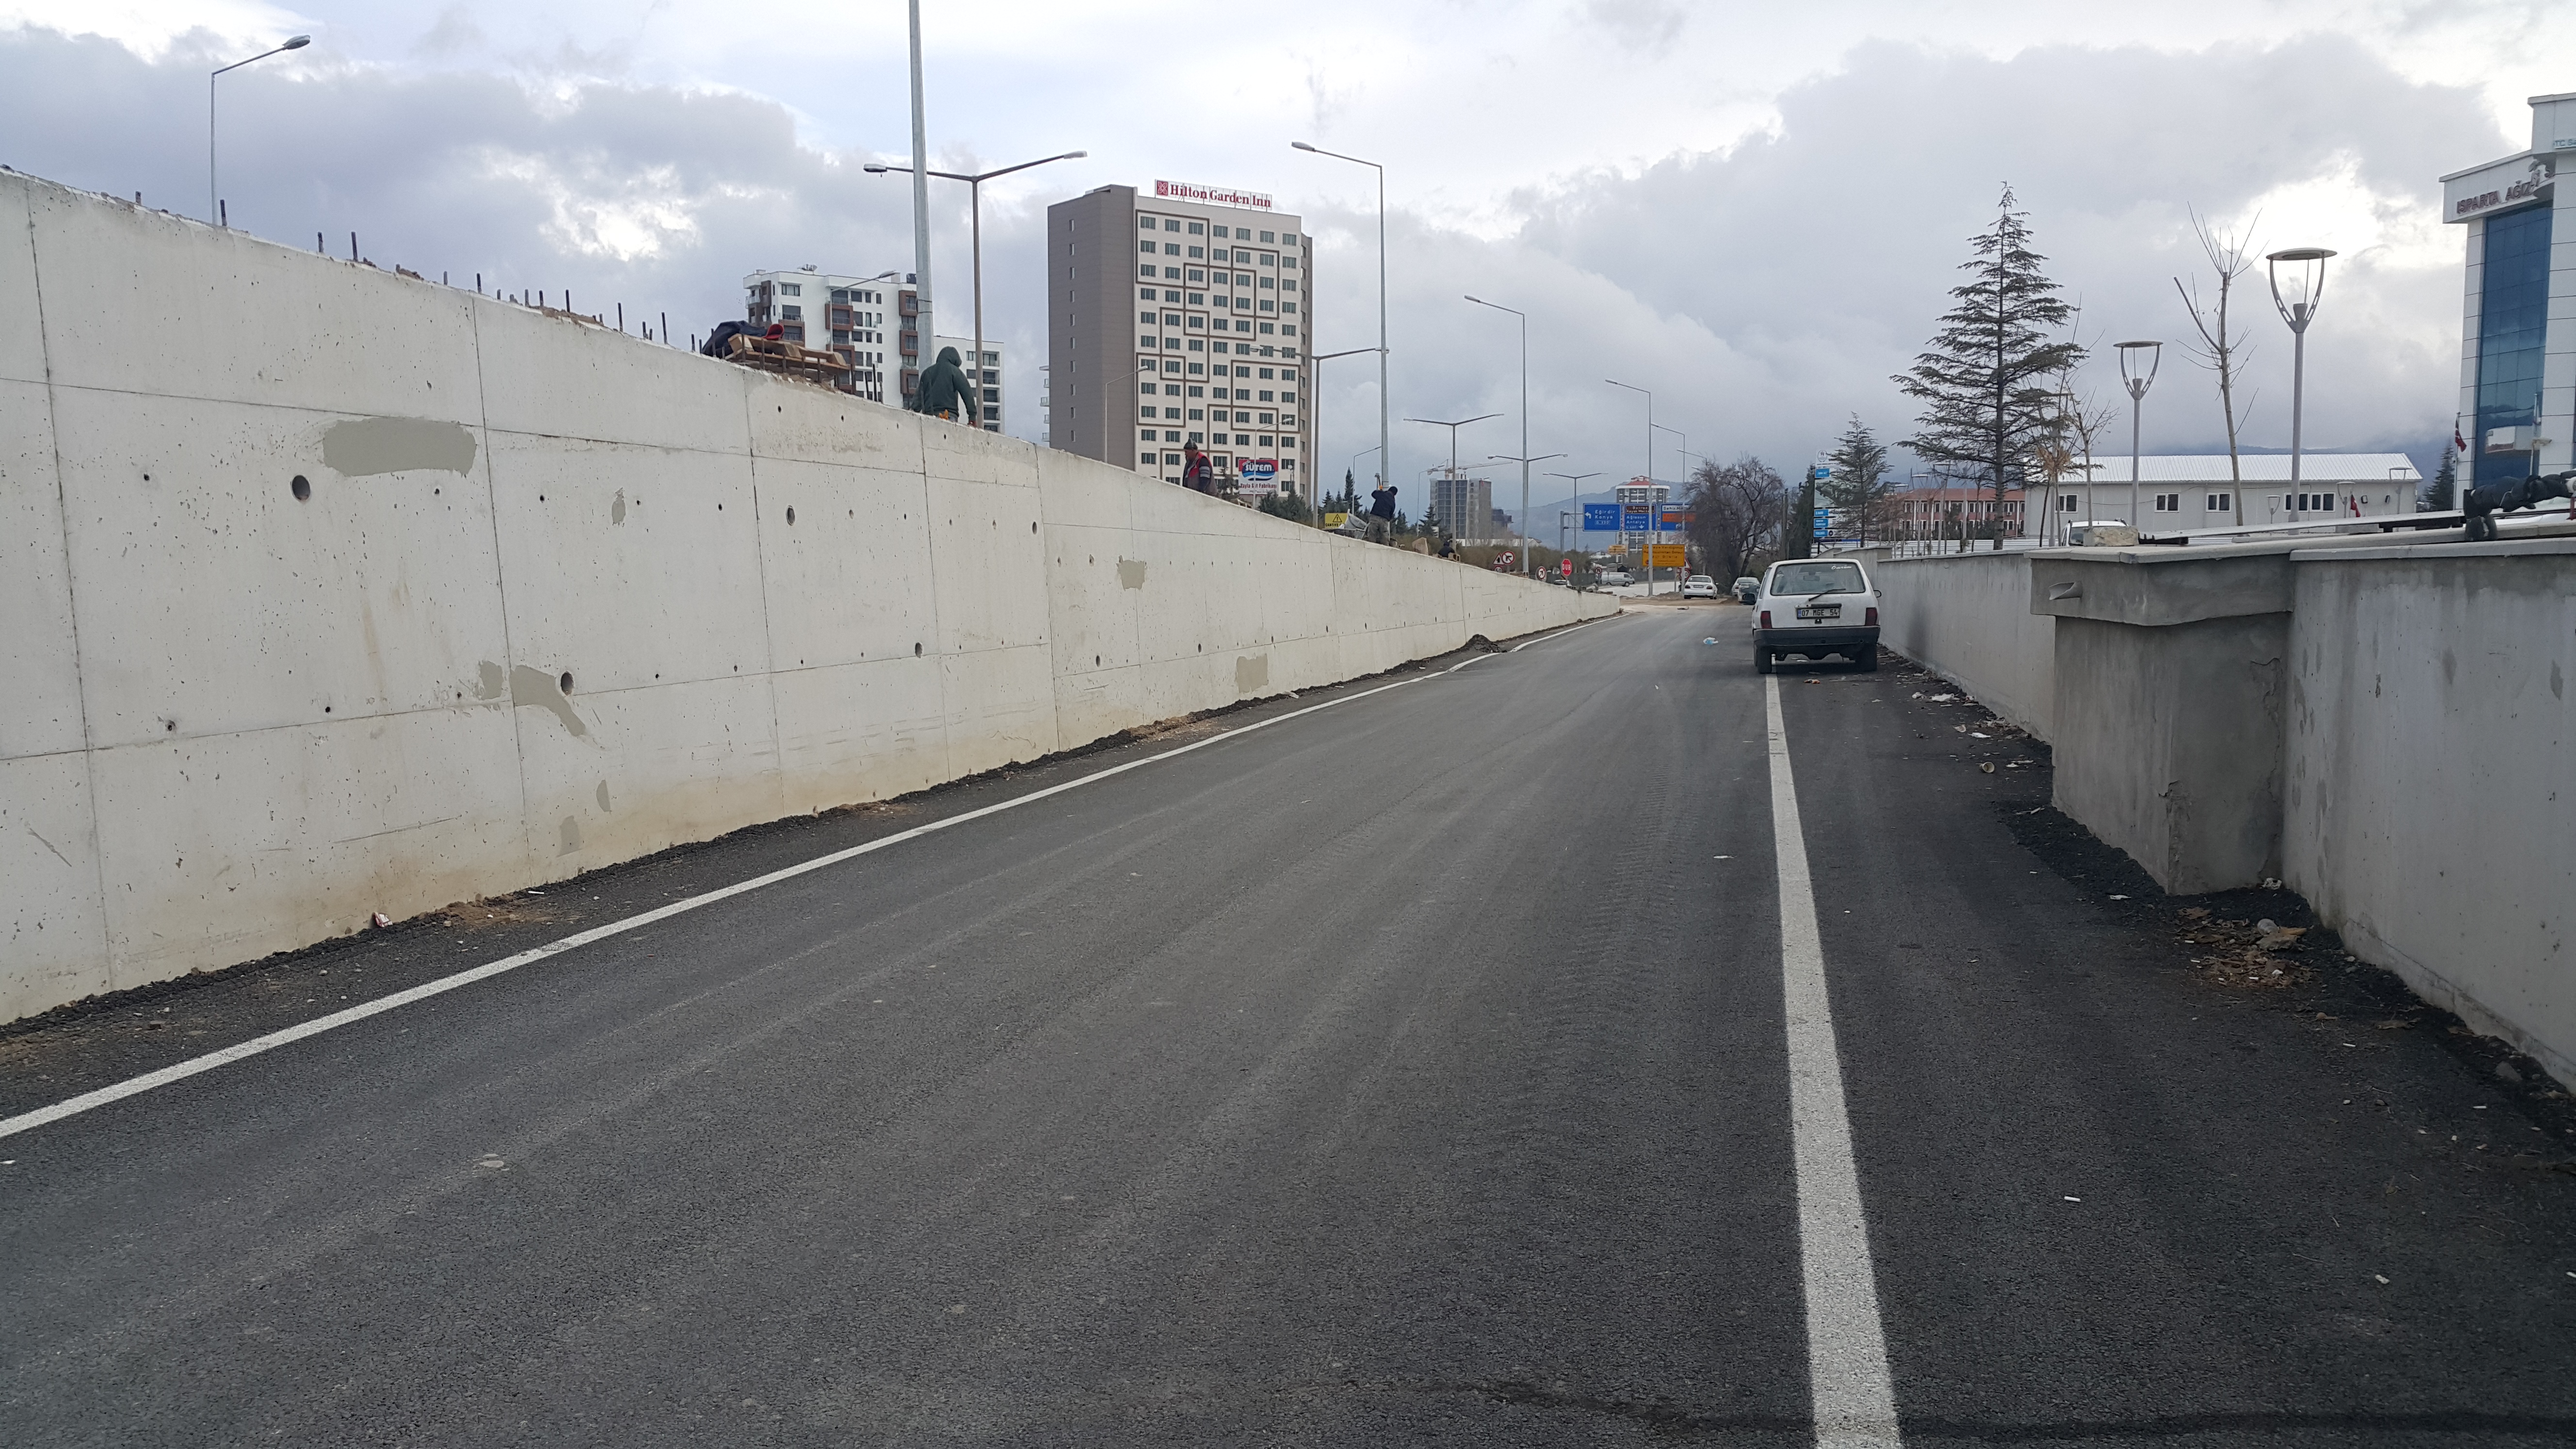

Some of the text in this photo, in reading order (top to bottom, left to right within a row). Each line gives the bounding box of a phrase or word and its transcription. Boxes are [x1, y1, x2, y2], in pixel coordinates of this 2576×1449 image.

[1170, 184, 1271, 208] Hilton Garden Inn
[2457, 190, 2500, 214] ISPARTA
[2505, 180, 2532, 201] AĞIZ
[1245, 463, 1272, 471] SÜTEM
